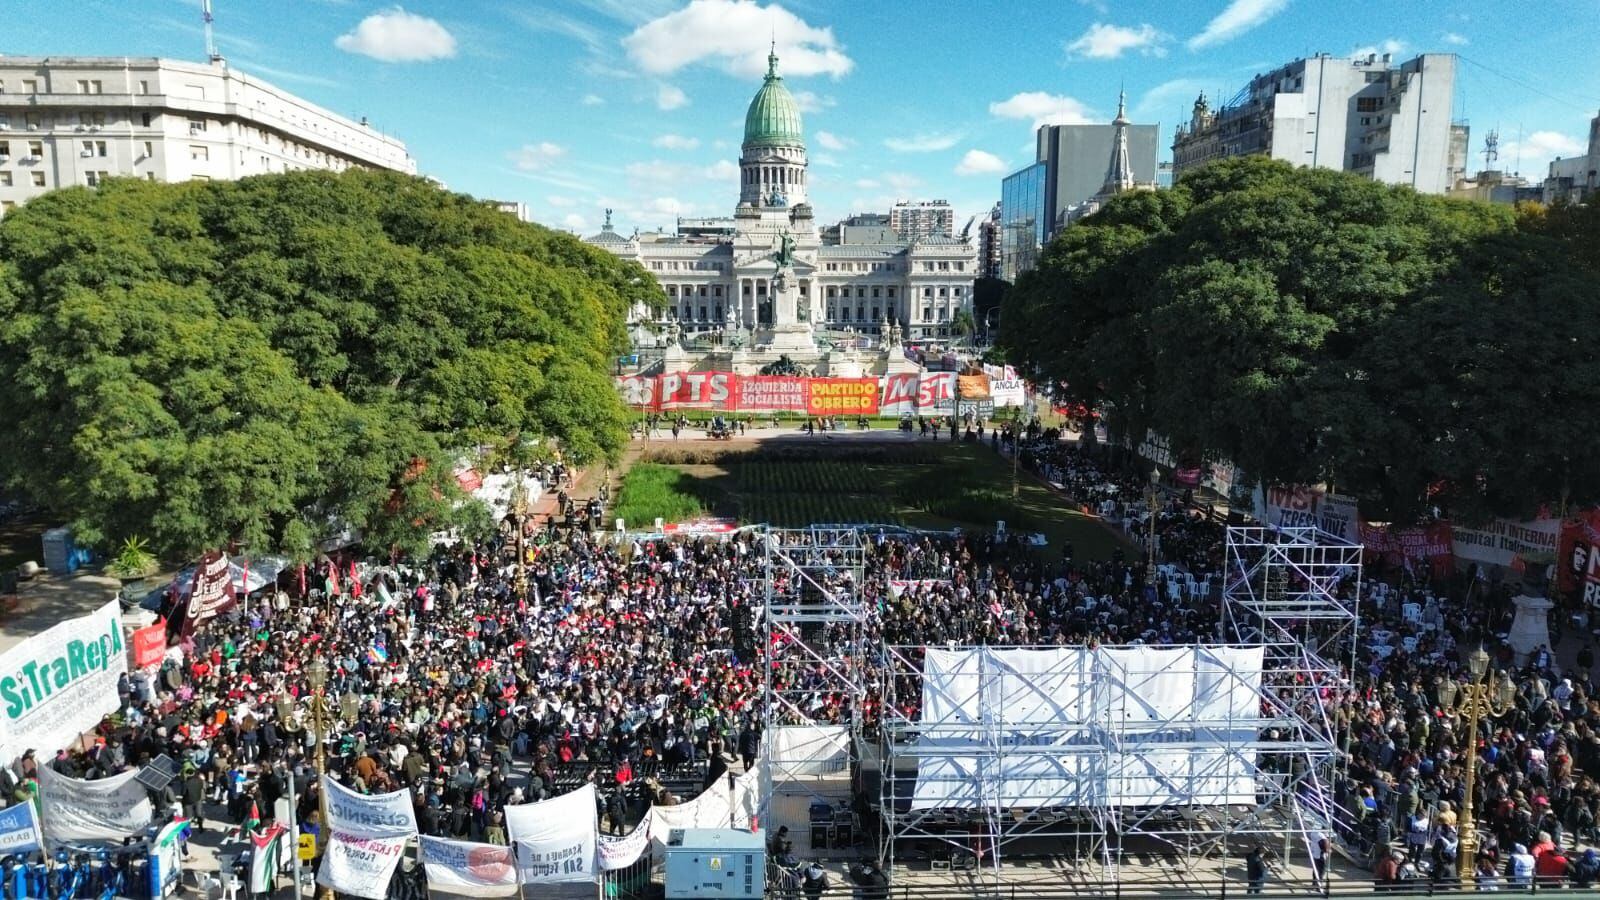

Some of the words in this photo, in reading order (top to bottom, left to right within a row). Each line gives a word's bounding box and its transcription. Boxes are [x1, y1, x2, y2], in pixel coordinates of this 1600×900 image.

[662, 374, 729, 402] PTS
[742, 380, 802, 394] IZQUIERDA
[812, 383, 875, 395] PARTIDO
[994, 380, 1020, 391] ANCLA
[742, 393, 803, 405] SOCIALISTA
[811, 396, 872, 409] OBRERO
[1280, 509, 1318, 529] TERESA
[1321, 518, 1347, 539] VIVE
[1453, 530, 1495, 547] ospital
[1509, 524, 1556, 547] INTERNA
